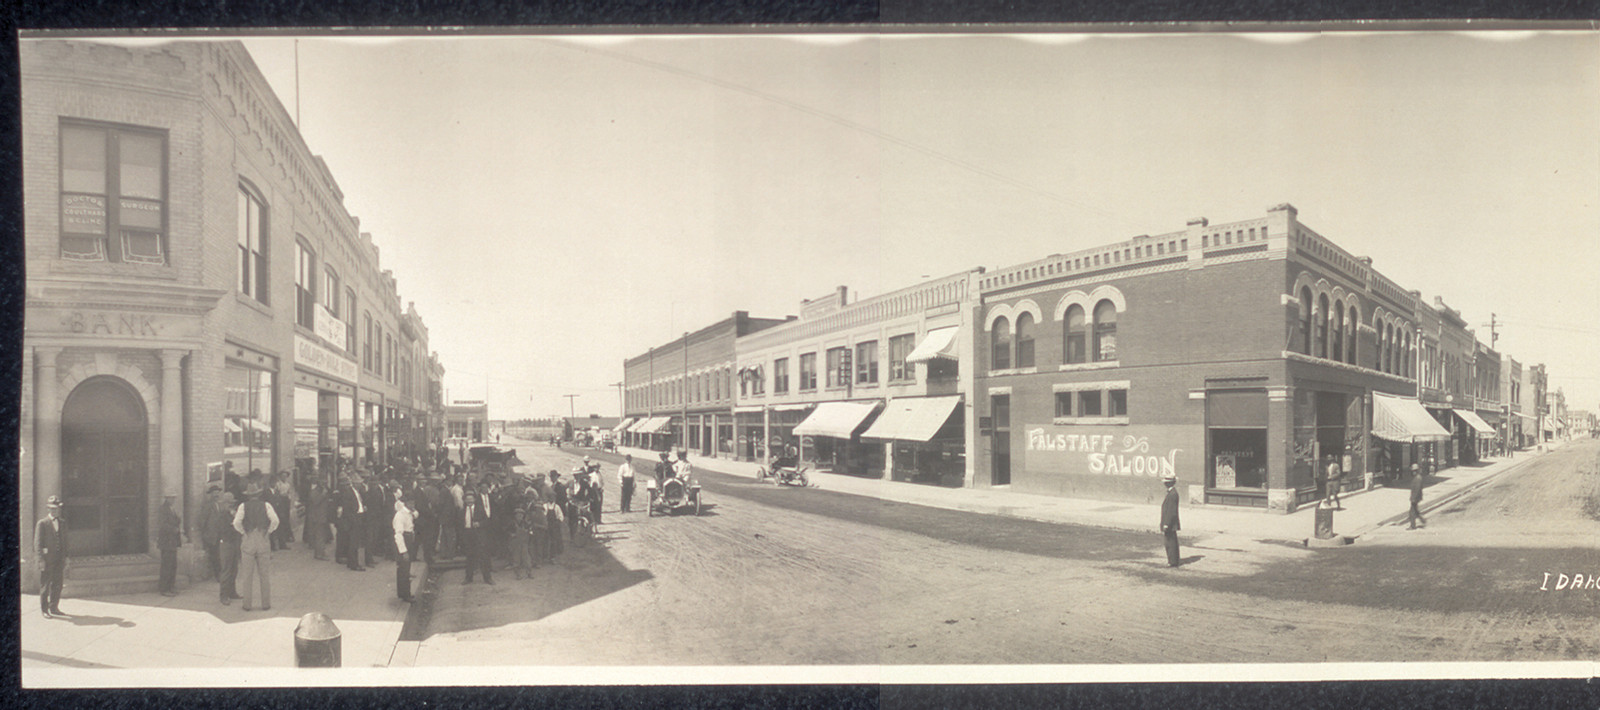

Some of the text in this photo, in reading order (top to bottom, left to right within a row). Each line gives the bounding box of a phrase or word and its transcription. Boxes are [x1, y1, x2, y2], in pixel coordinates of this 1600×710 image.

[71, 311, 157, 336] BANK
[1027, 427, 1113, 452] FALSTAFF
[1088, 448, 1184, 478] SALOON
